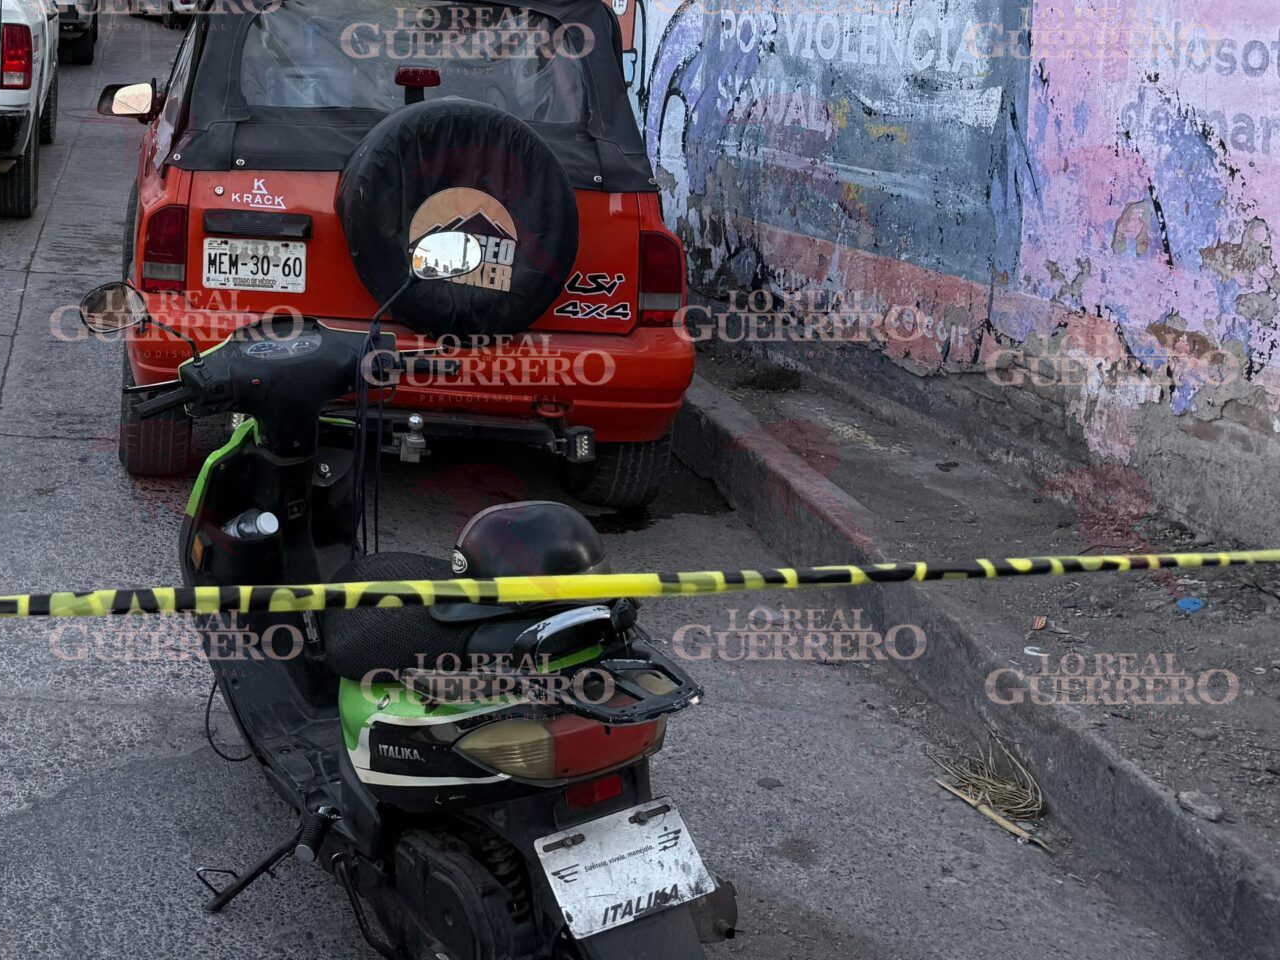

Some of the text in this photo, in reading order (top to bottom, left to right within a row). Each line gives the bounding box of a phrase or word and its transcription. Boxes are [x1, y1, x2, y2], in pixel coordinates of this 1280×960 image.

[785, 12, 982, 72] VIOLENCIA
[231, 192, 287, 209] KRACK
[207, 252, 303, 278] MEM-30-60
[378, 743, 421, 761] ITALIKA
[601, 883, 679, 926] ITALIKA
